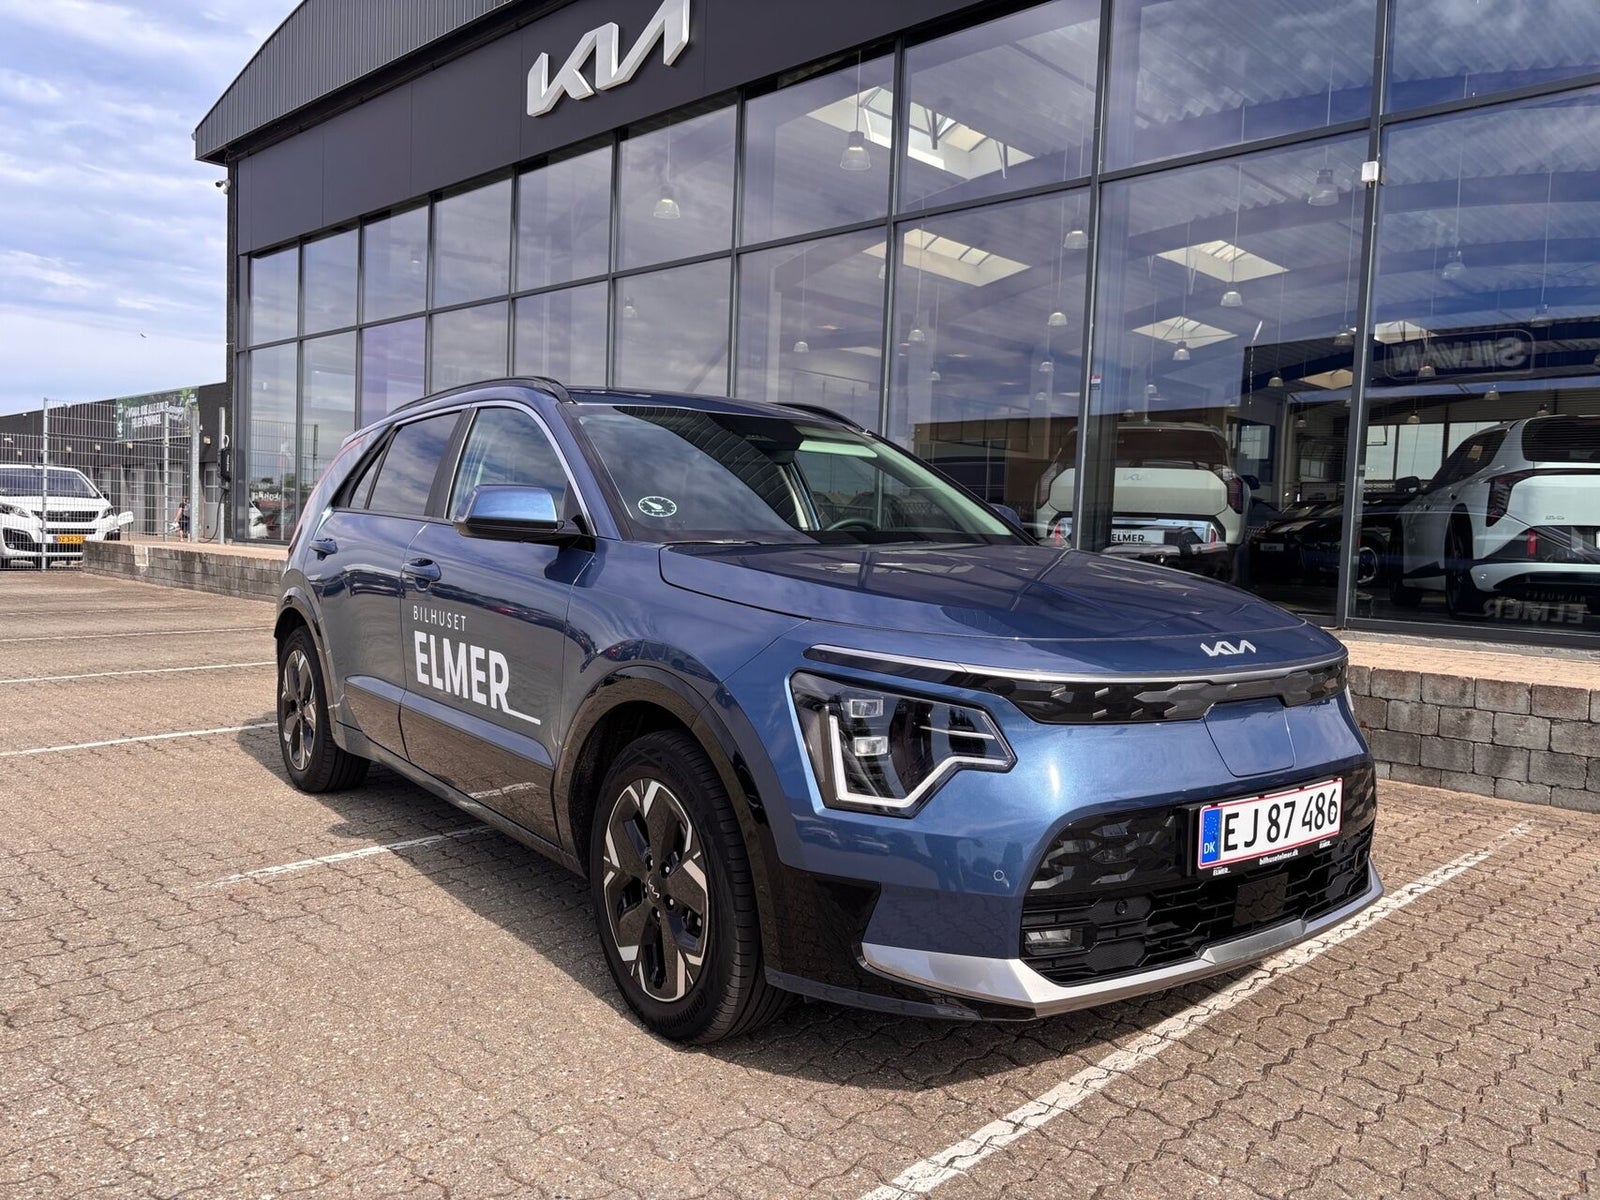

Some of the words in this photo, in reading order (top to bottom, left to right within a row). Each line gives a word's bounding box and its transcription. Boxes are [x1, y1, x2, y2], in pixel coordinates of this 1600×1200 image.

[1111, 534, 1146, 542] ELMER
[413, 605, 467, 632] BILHUSET
[1200, 639, 1257, 657] KIA
[414, 630, 541, 725] ELMER
[1223, 808, 1259, 852] EJ
[1266, 800, 1296, 843] 87
[1301, 788, 1338, 832] 486
[1203, 841, 1216, 855] DK
[1258, 849, 1299, 866] bilhusetelmer.dk
